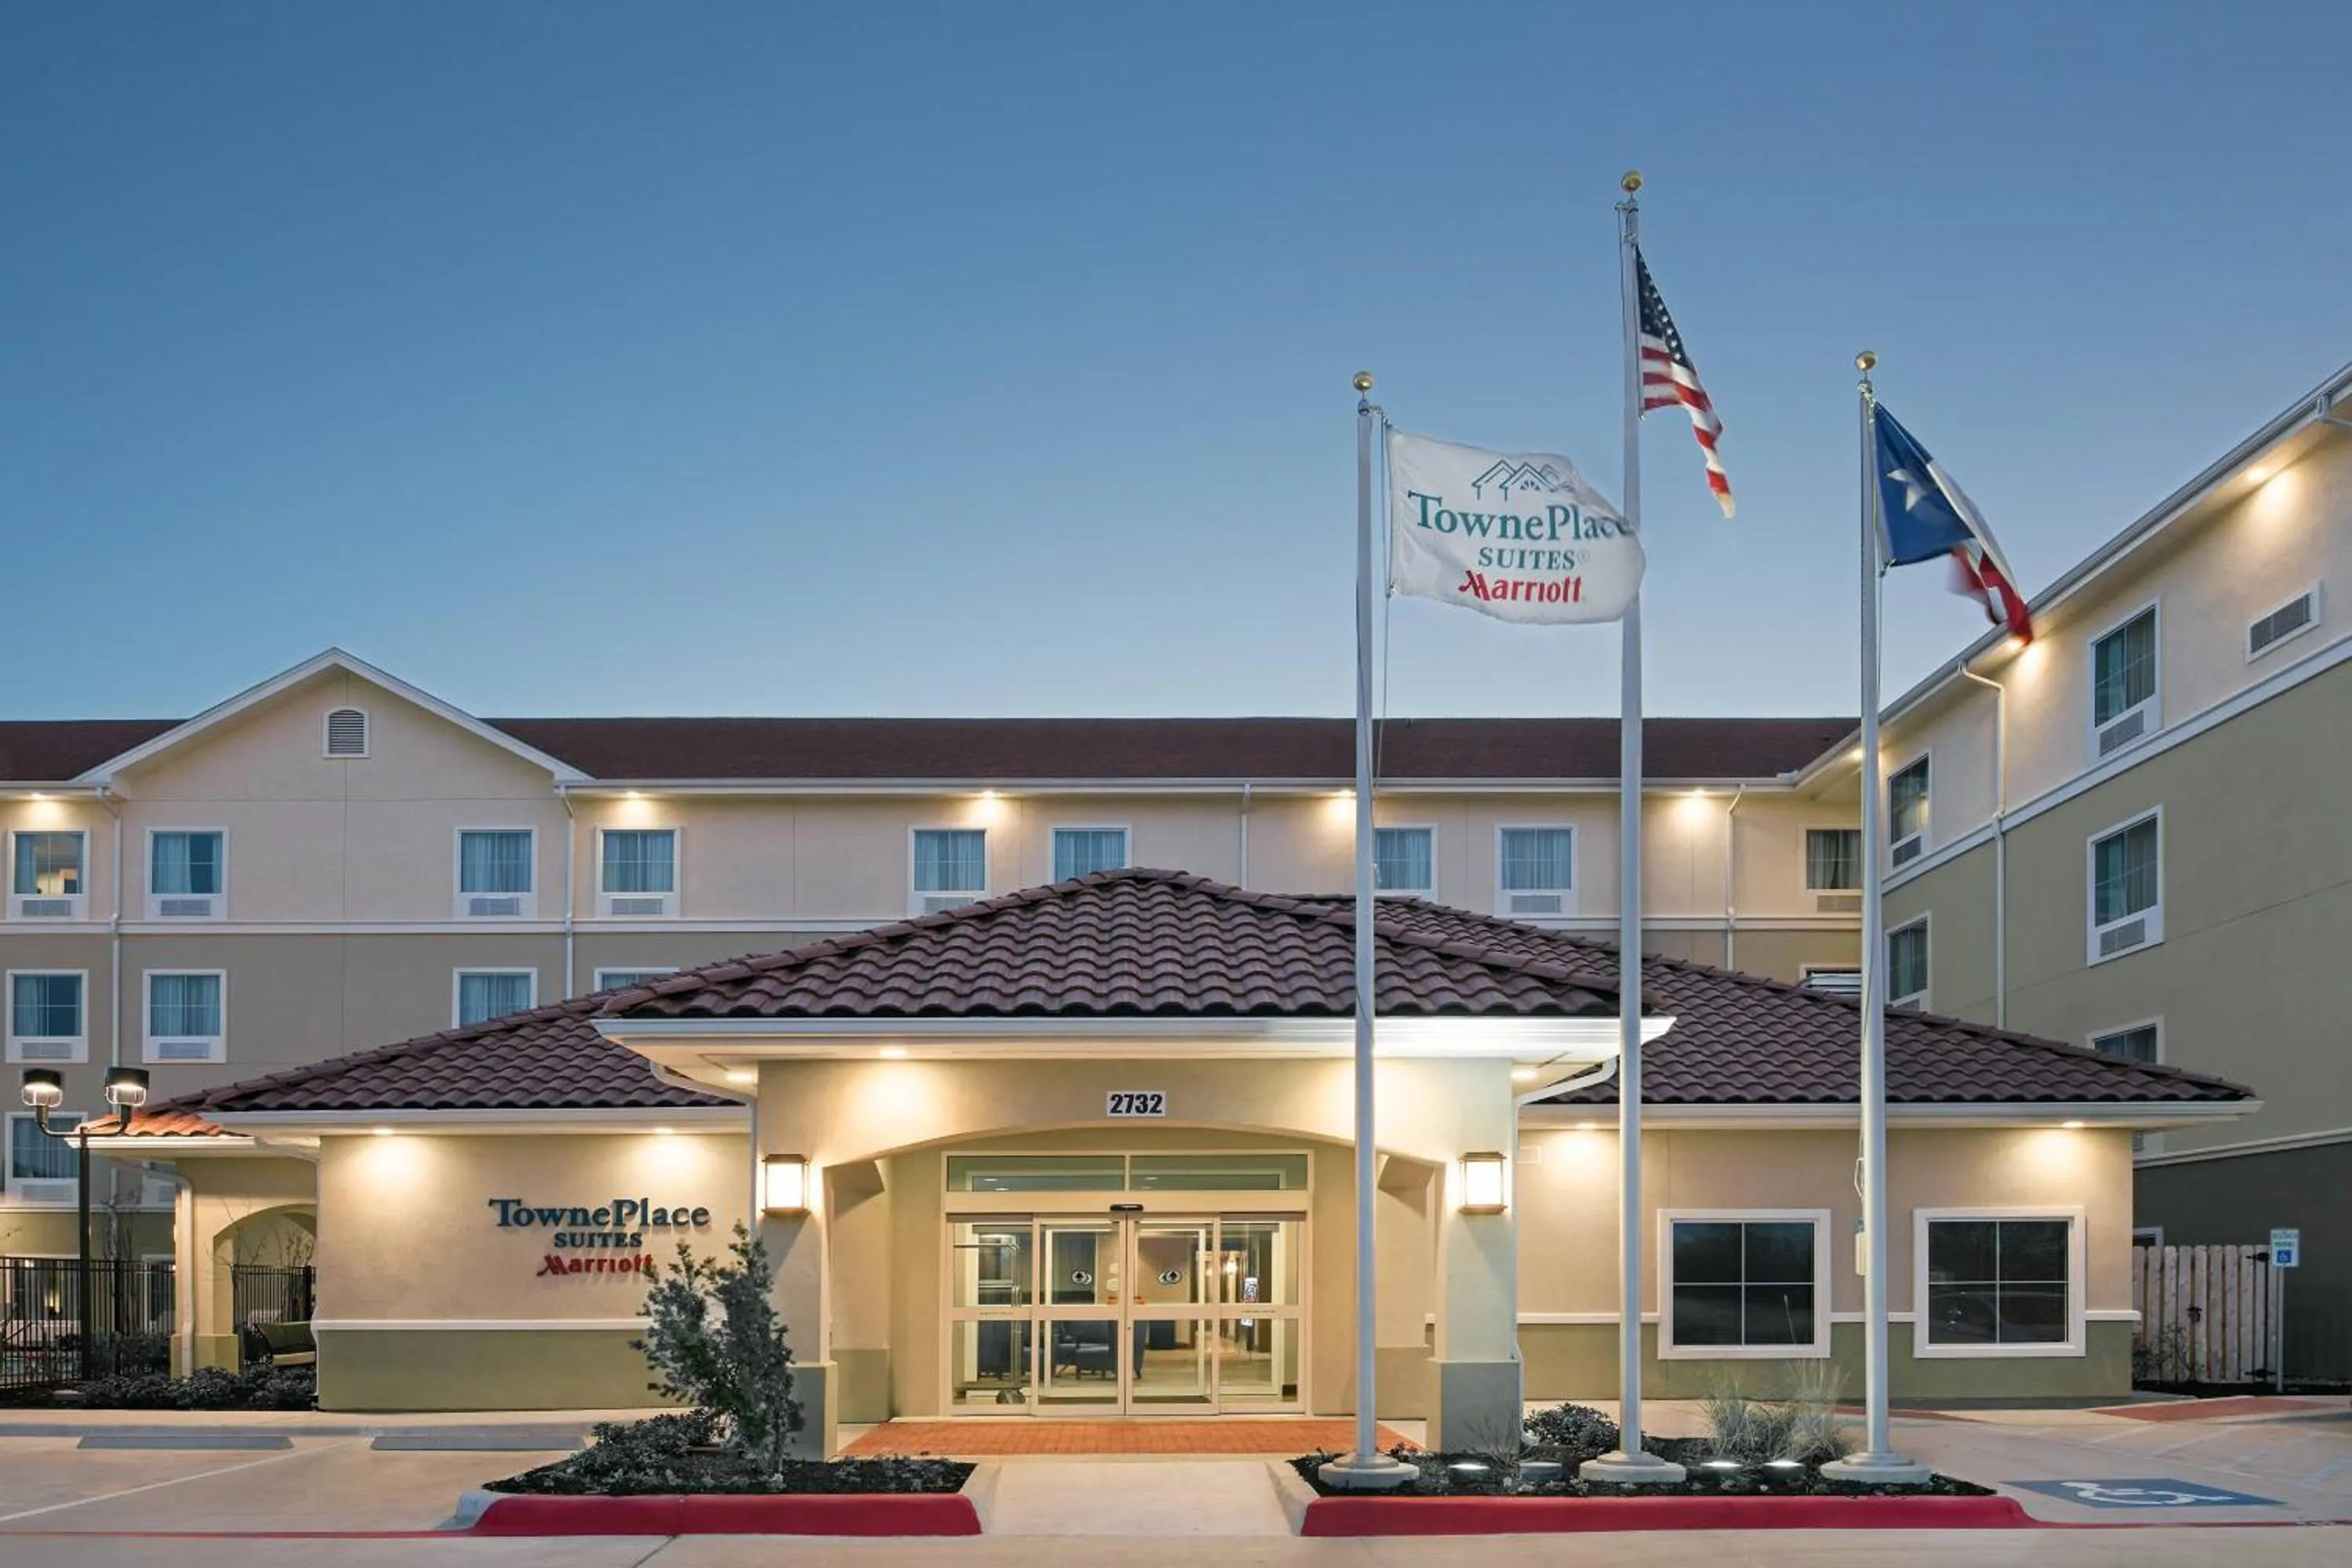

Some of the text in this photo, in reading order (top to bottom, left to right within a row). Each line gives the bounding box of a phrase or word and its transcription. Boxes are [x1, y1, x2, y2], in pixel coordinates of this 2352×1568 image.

[1407, 490, 1635, 540] TownePlace
[1458, 570, 1581, 603] Marriott
[1109, 1094, 1163, 1114] 2732
[488, 1197, 710, 1228] TownePlace
[554, 1232, 643, 1248] SUITES
[536, 1254, 653, 1276] Marriott
